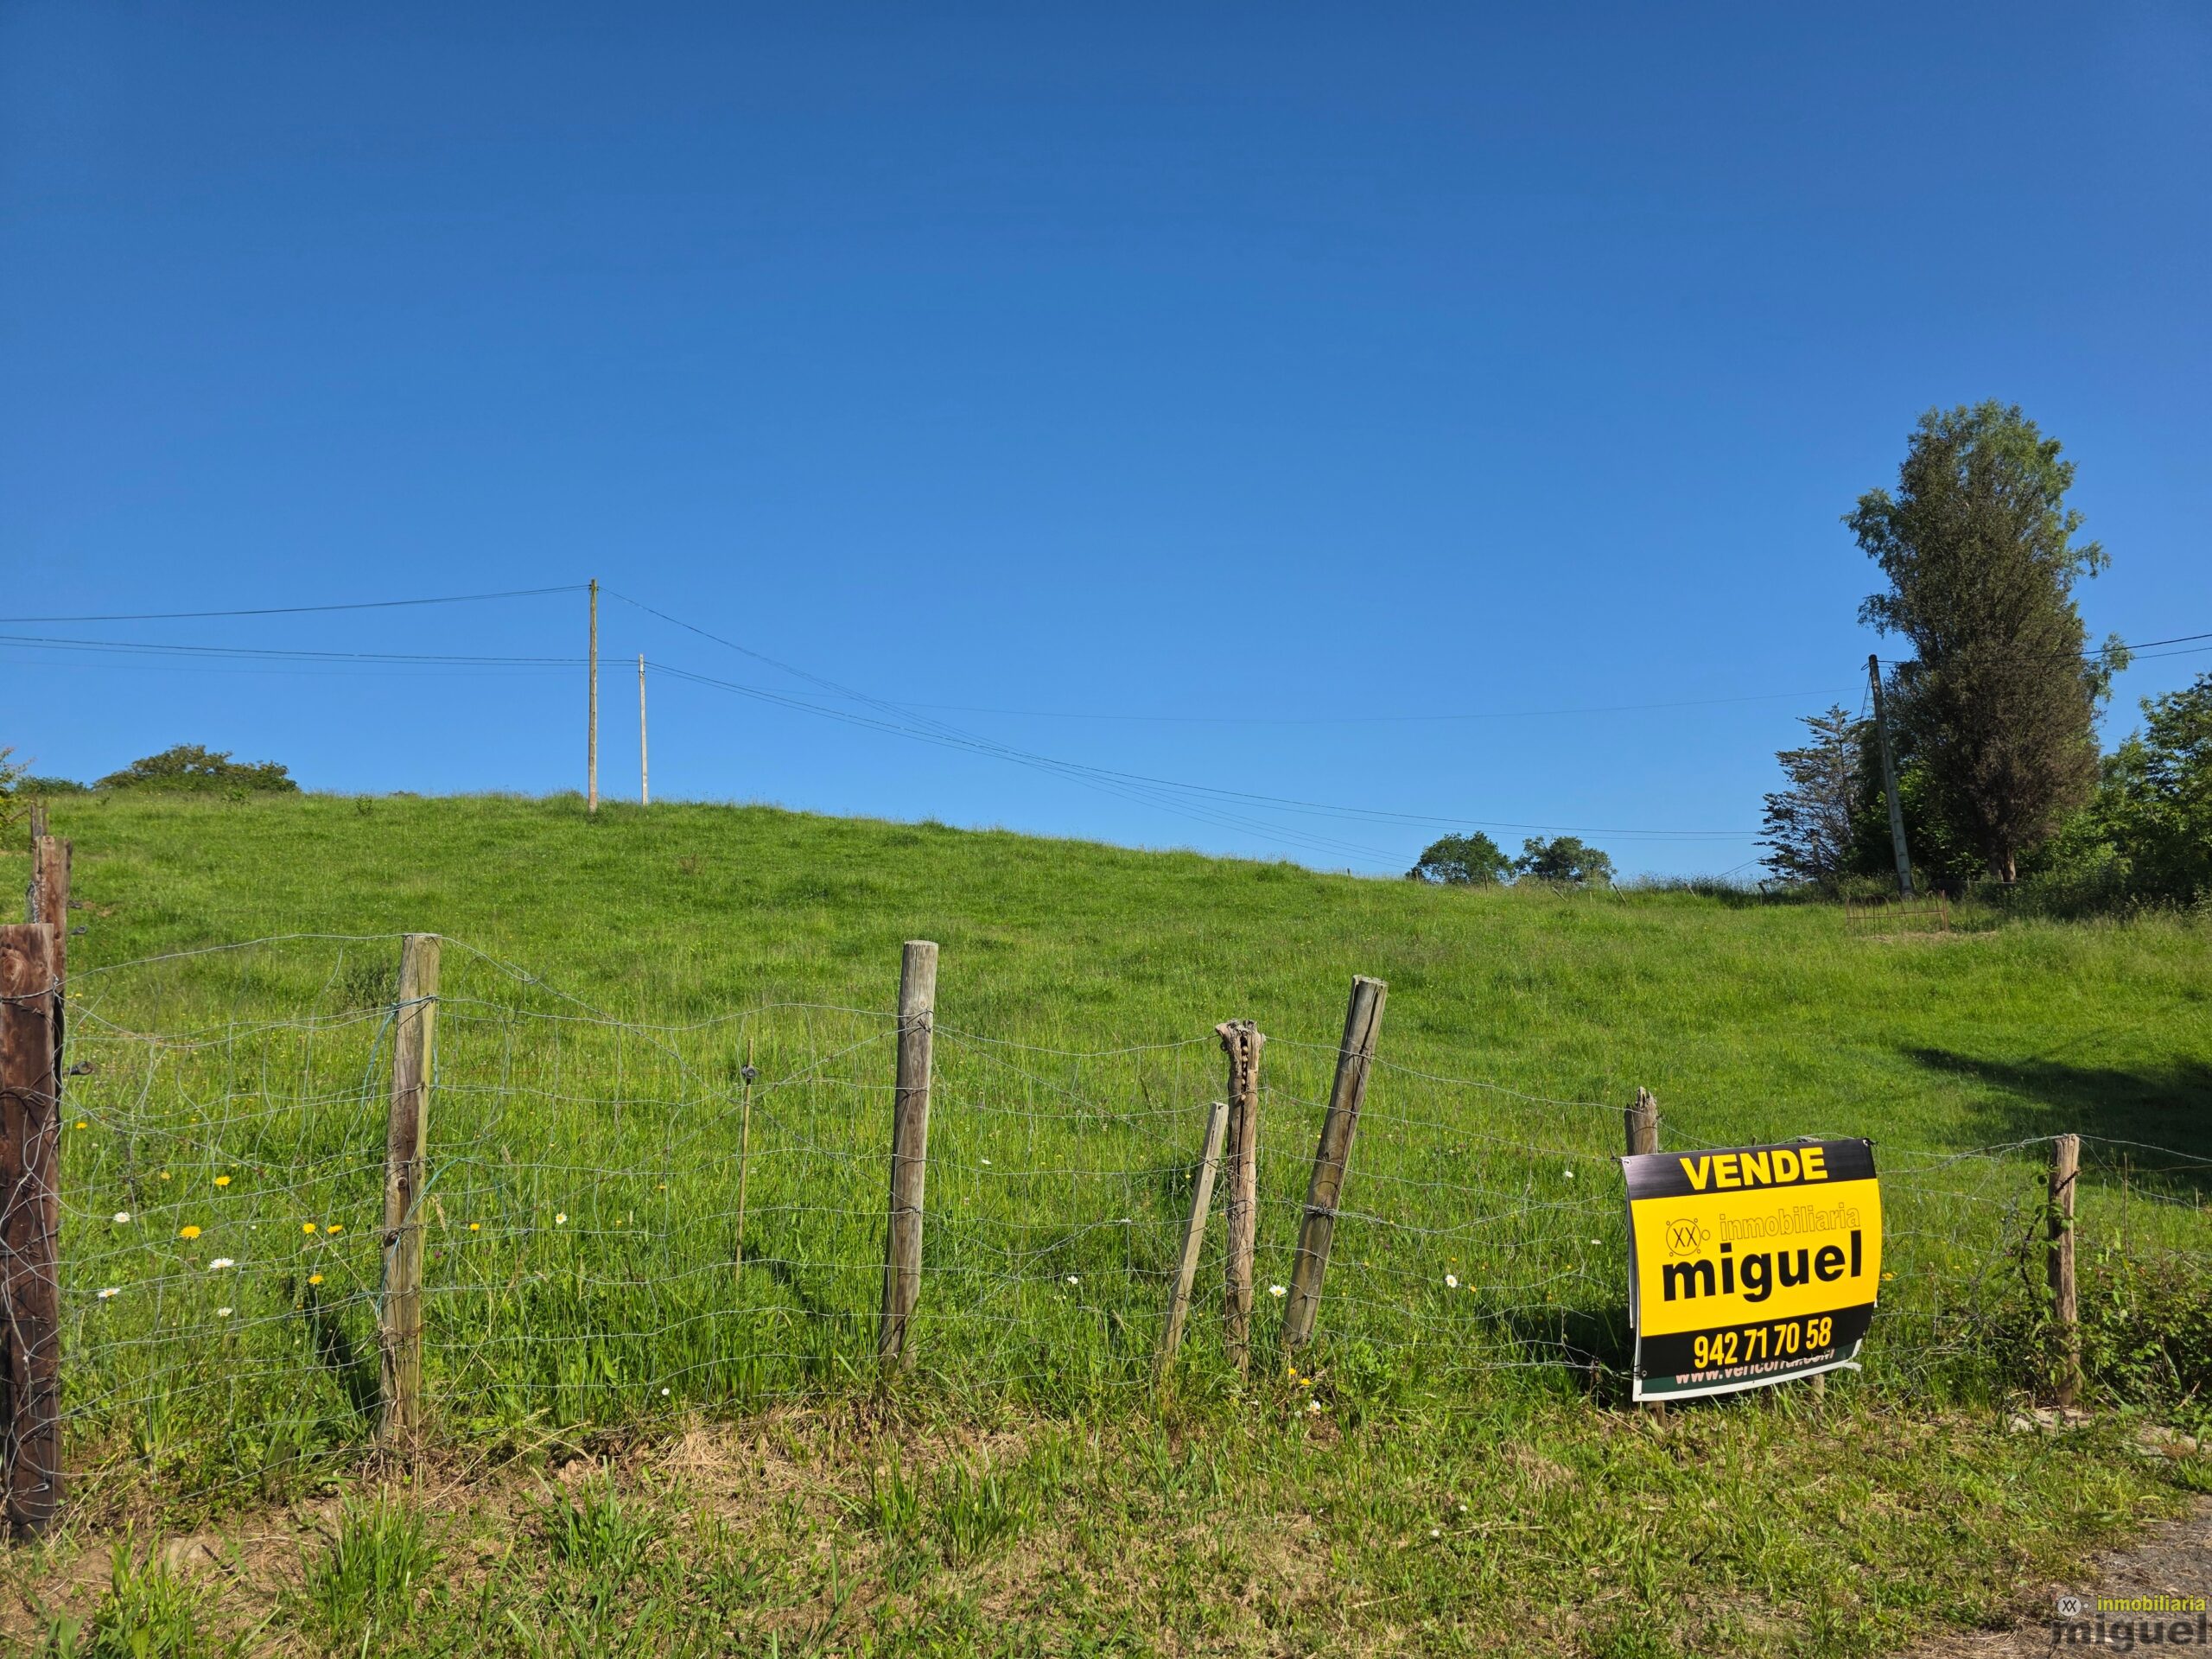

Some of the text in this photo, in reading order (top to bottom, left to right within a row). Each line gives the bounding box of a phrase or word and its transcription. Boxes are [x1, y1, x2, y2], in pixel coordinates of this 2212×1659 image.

[1680, 1147, 1827, 1190] VENDE
[1719, 1202, 1861, 1241] inmobiliaria
[1662, 1230, 1862, 1302] miguel
[1694, 1317, 1833, 1369] 942 71 70 58
